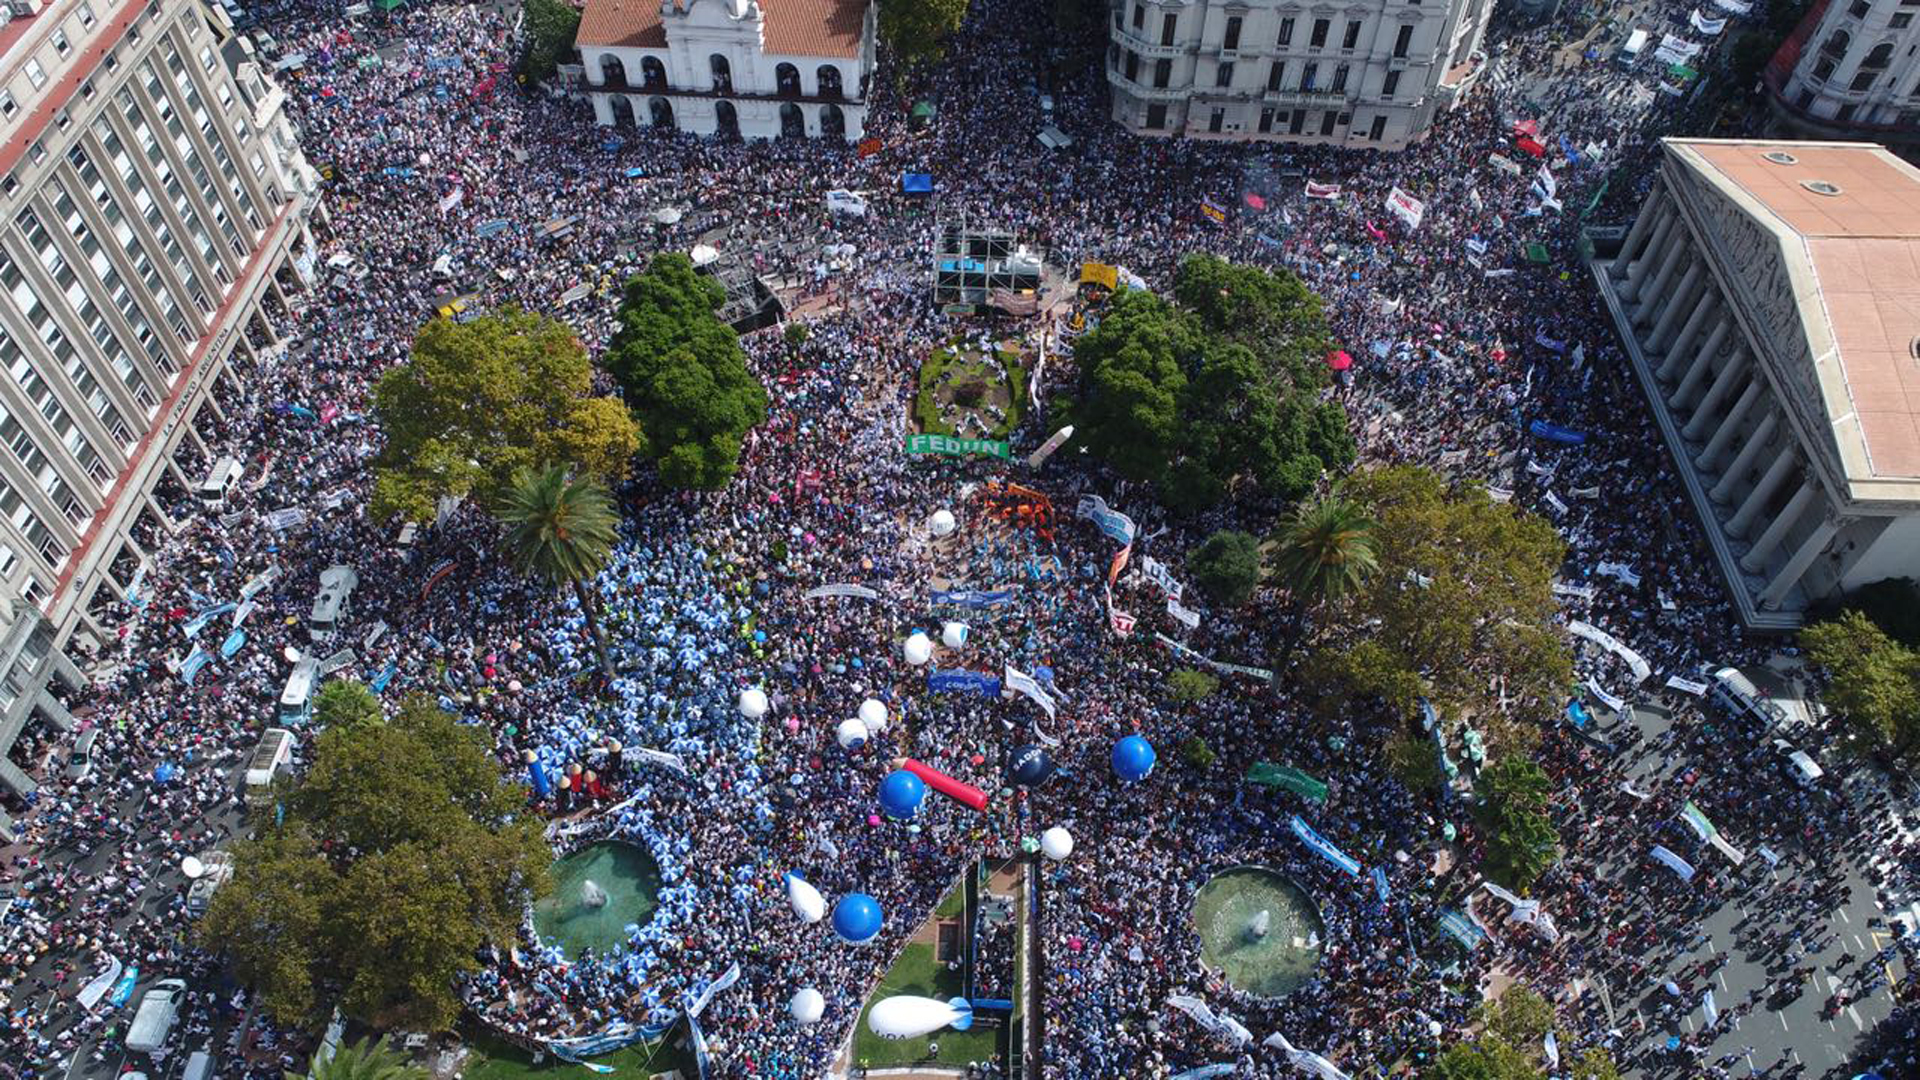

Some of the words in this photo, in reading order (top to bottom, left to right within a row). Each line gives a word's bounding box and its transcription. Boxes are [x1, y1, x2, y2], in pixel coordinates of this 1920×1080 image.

[173, 382, 197, 419] FRANCO
[198, 327, 229, 377] ARGENTINA
[911, 435, 1000, 455] FEDUN
